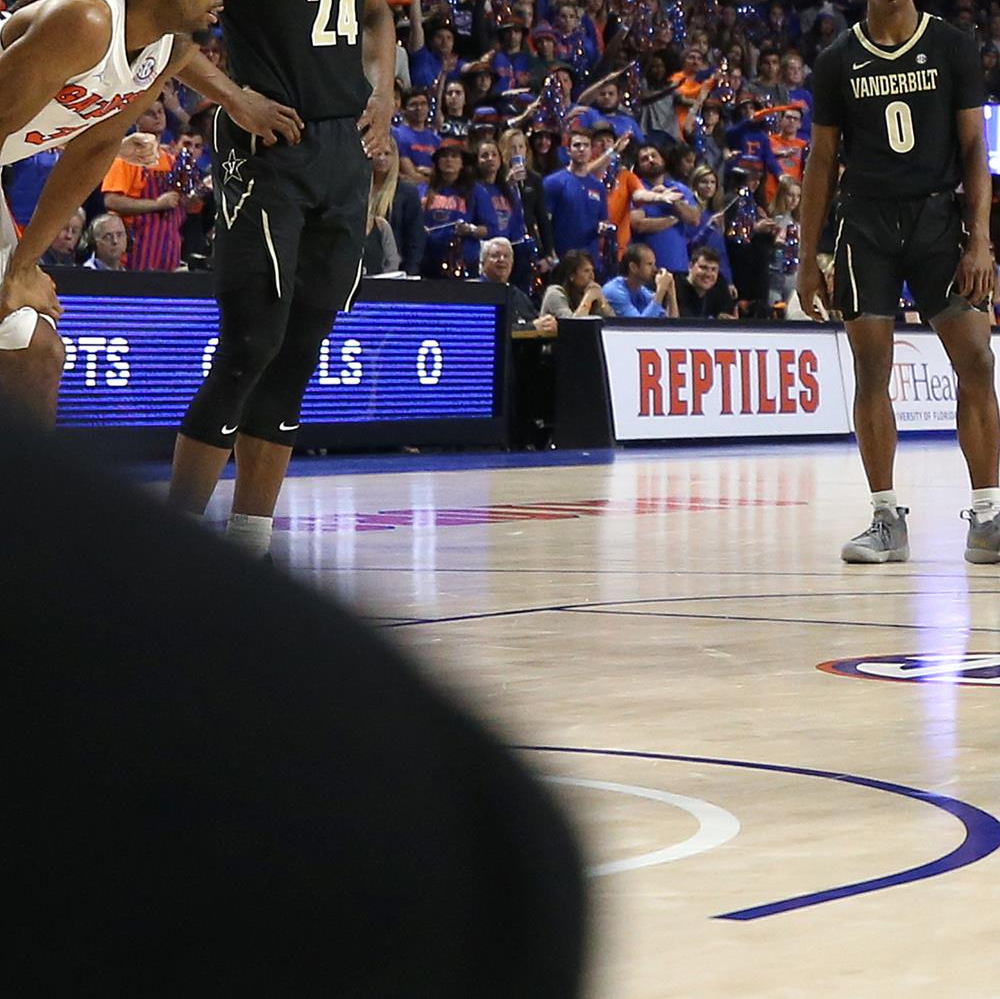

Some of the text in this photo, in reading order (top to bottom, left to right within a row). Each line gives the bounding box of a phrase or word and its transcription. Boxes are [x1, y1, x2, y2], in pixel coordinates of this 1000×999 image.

[850, 69, 938, 99] VANDERBILT
[885, 100, 915, 153] 0
[636, 349, 820, 417] REPTILES
